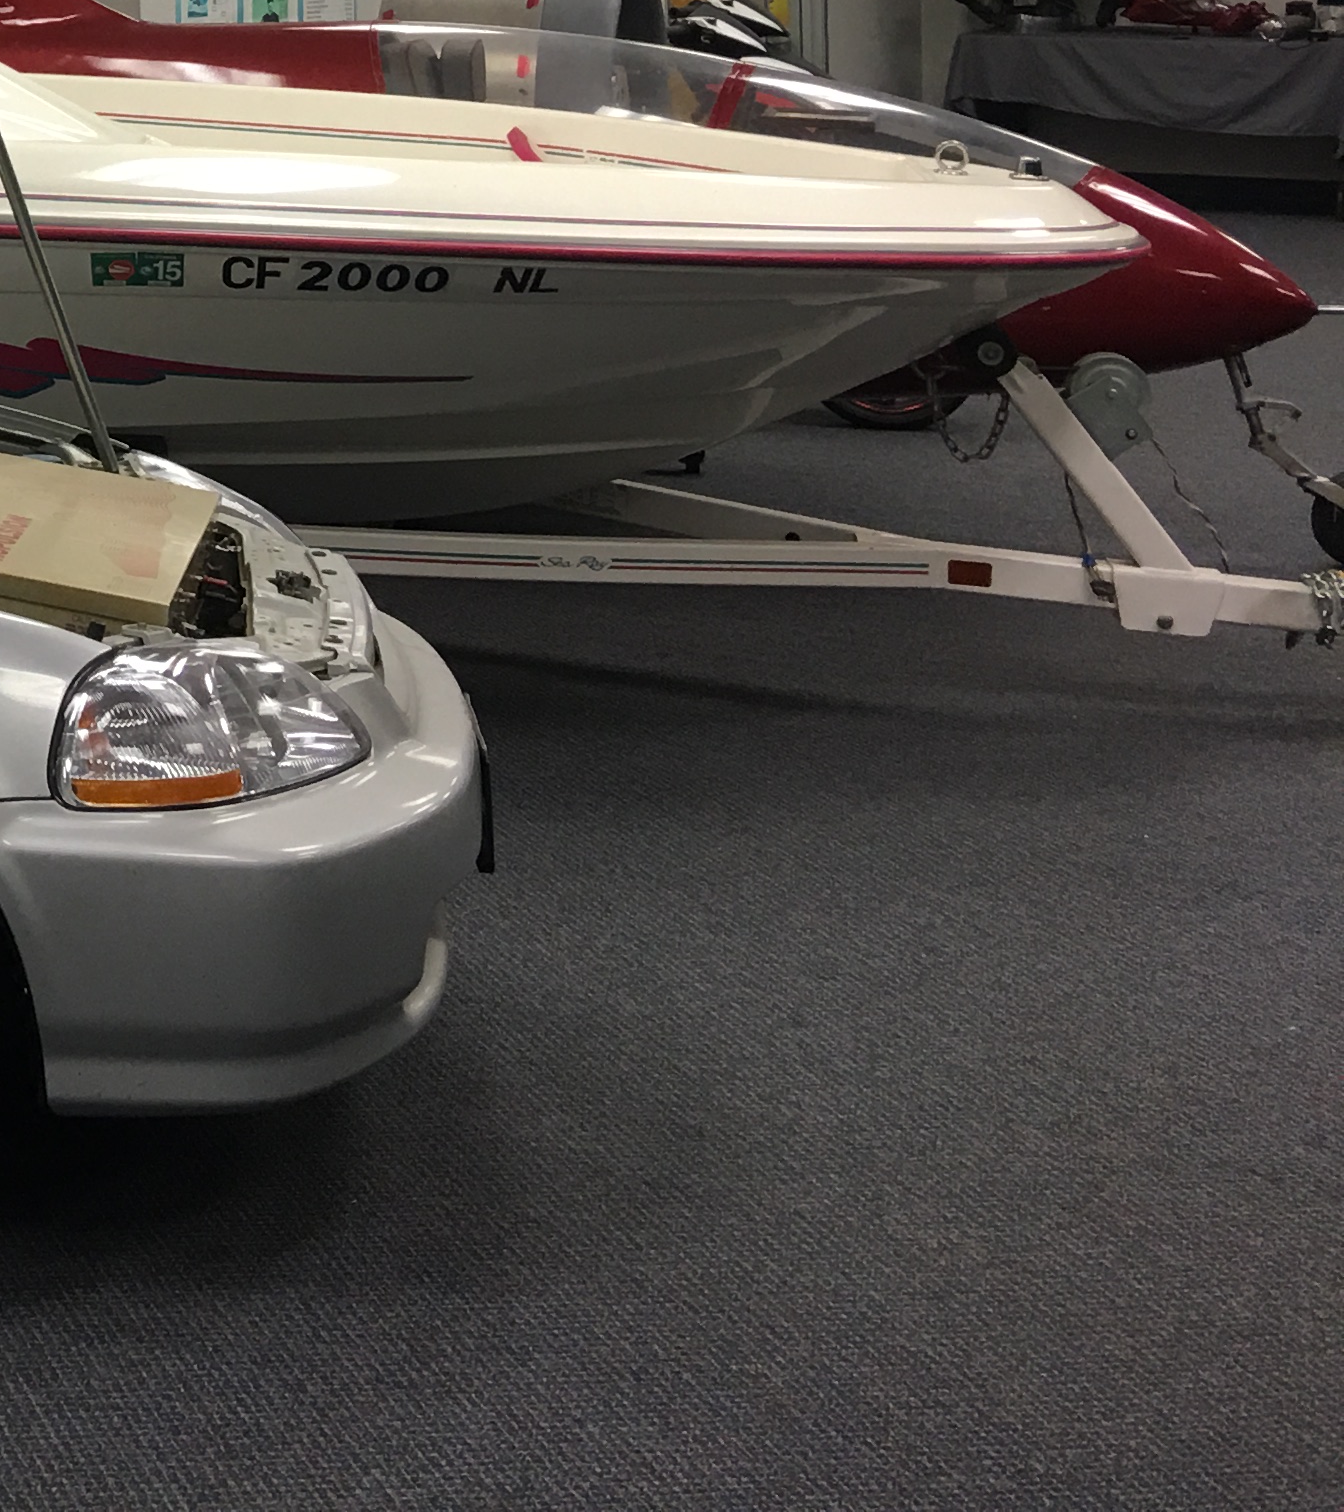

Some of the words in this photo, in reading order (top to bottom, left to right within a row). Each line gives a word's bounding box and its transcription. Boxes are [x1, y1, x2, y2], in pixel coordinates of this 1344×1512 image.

[152, 260, 182, 281] 15
[221, 256, 289, 290] CF
[297, 260, 450, 293] 2000
[493, 267, 559, 294] NL
